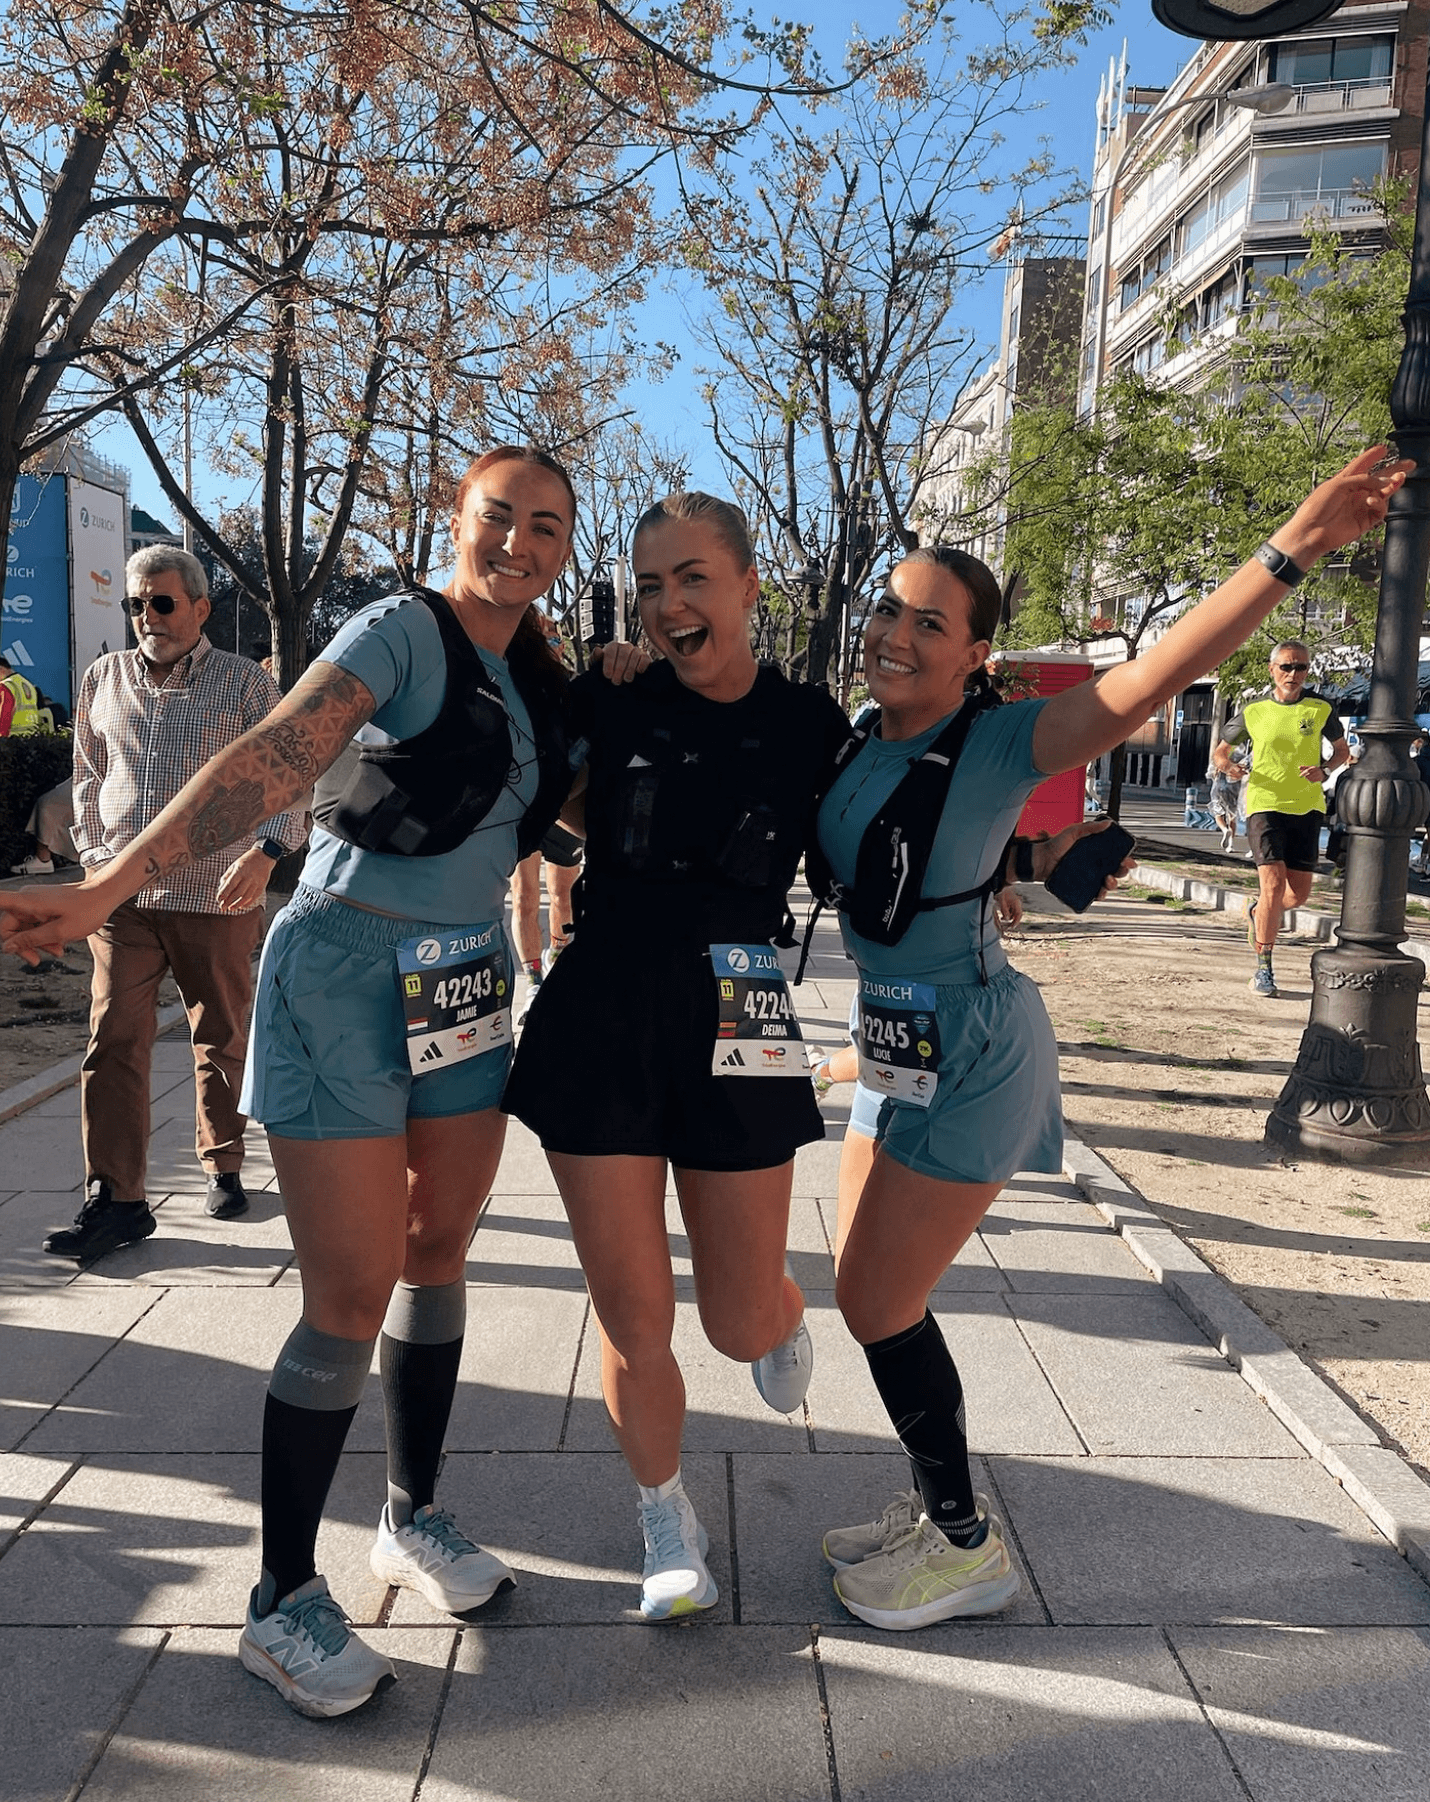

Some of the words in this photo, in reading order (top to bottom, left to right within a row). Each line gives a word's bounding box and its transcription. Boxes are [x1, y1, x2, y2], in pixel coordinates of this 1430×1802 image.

[92, 515, 115, 532] ZURICH
[6, 567, 35, 578] RICH
[449, 931, 492, 955] ZURICH
[755, 954, 779, 970] ZUR
[408, 979, 418, 991] 11
[433, 967, 492, 1010] 42243
[723, 984, 732, 995] 11
[863, 980, 913, 1001] ZURICH
[456, 1005, 478, 1023] JAMIE
[303, 1366, 338, 1383] cep
